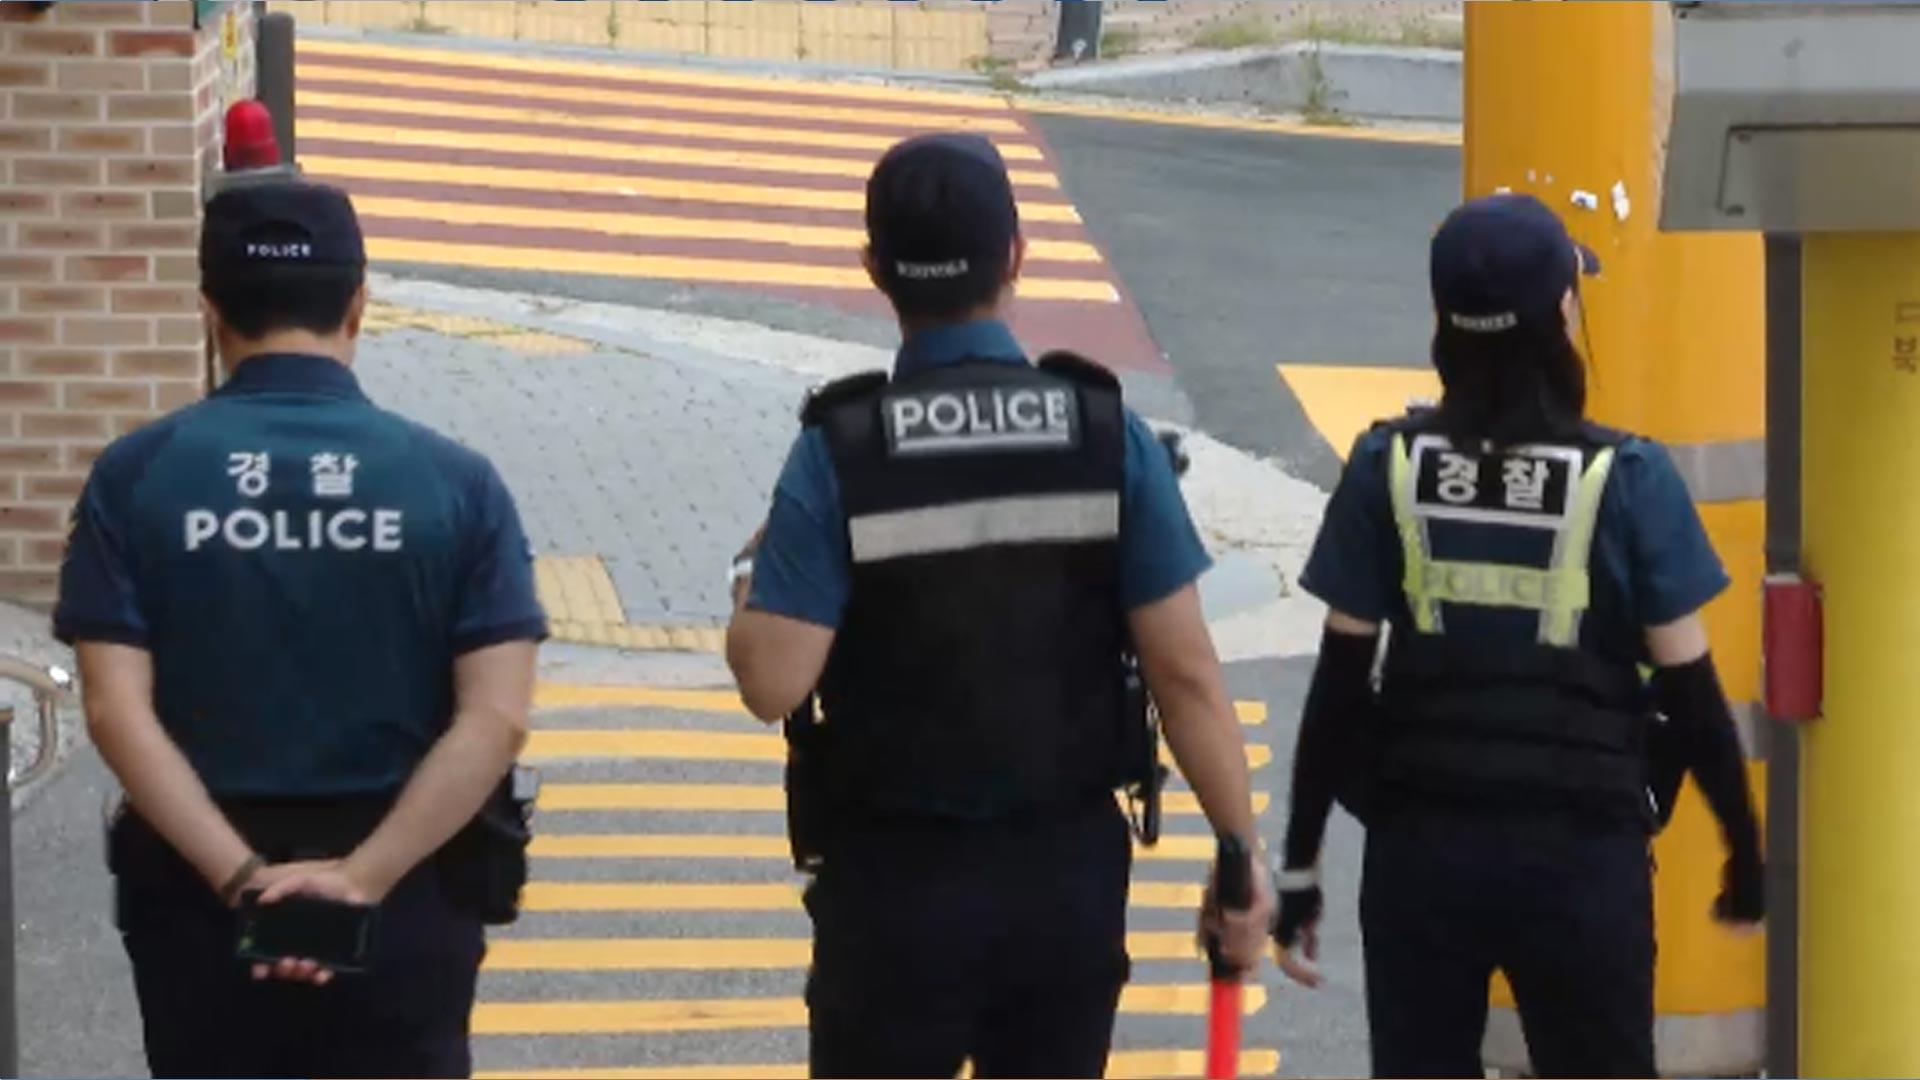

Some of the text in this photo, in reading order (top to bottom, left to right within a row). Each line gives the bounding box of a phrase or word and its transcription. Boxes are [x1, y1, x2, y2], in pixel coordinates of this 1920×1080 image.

[246, 243, 311, 257] POLICE
[893, 388, 1069, 437] POLICE
[184, 509, 402, 551] POLICE
[1421, 563, 1564, 604] POLICE
